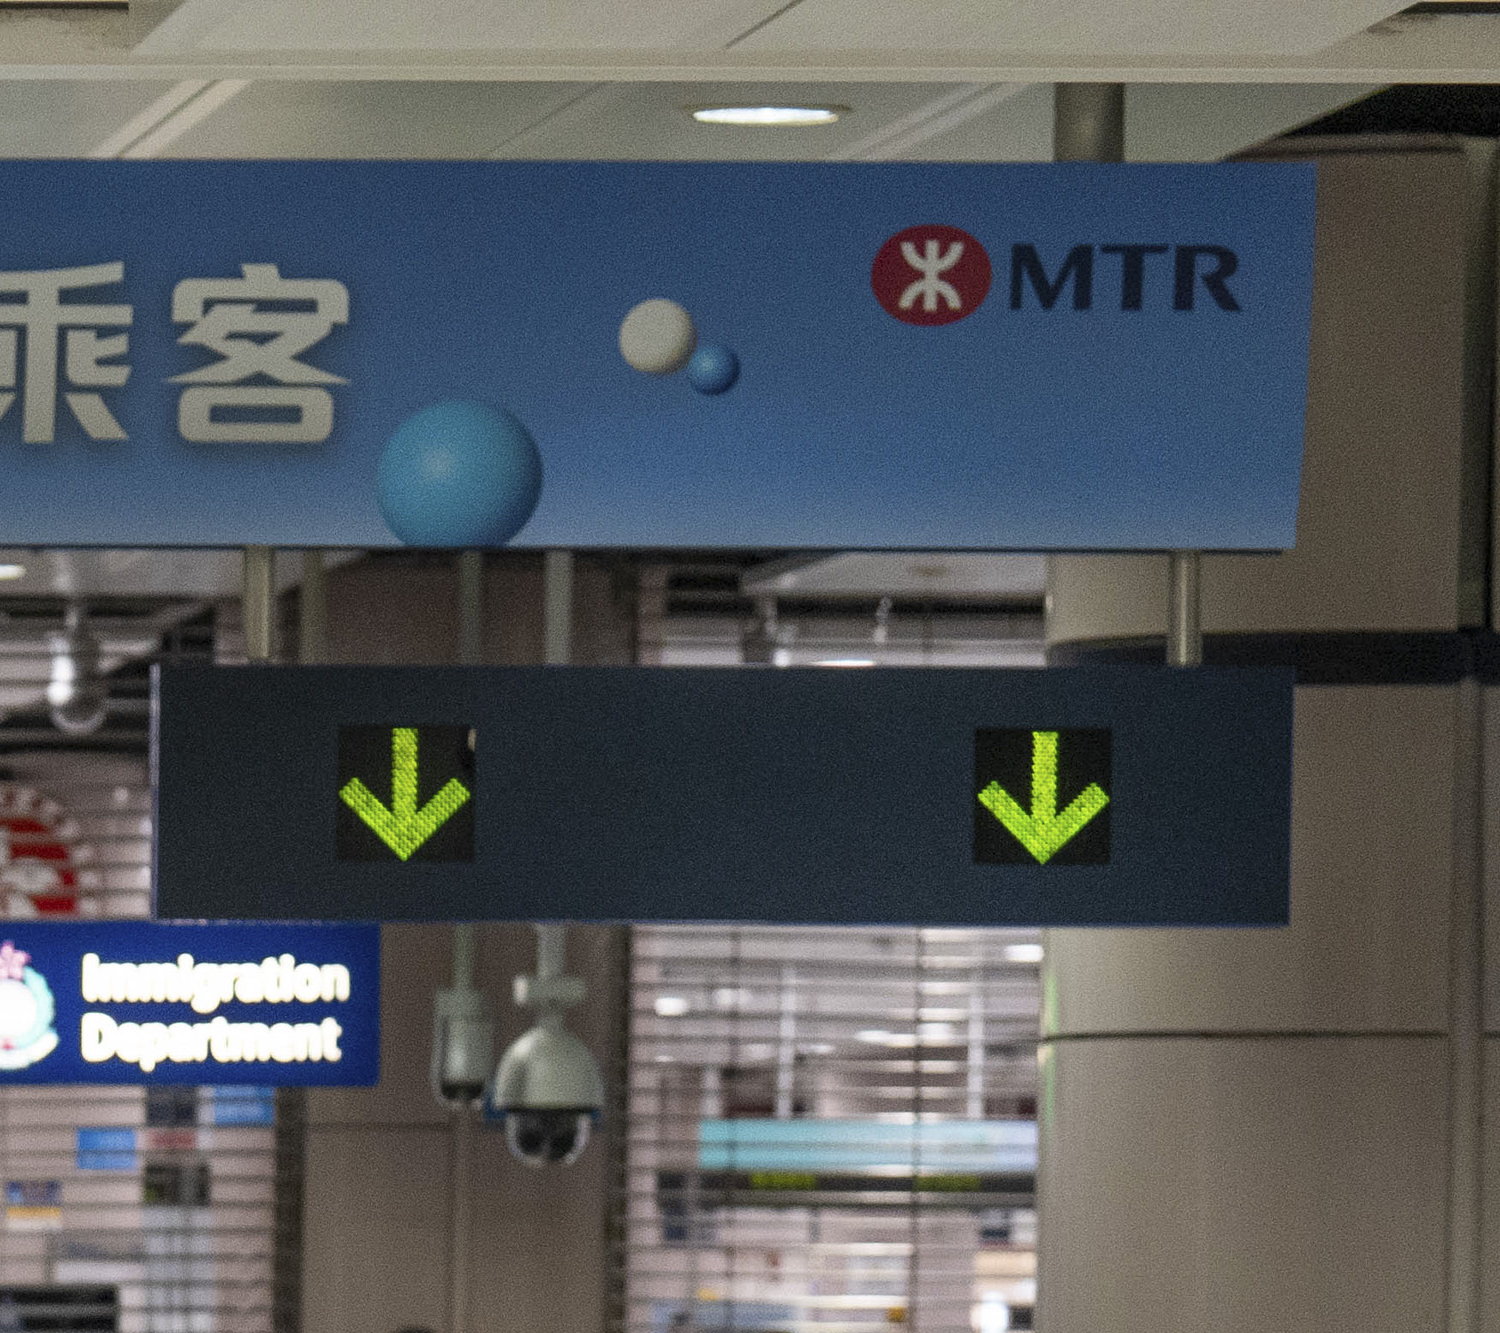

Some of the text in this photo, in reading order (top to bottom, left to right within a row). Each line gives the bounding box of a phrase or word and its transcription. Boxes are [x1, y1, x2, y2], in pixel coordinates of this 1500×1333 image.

[1008, 242, 1242, 313] MTR
[80, 953, 351, 1014] Immigration
[80, 1011, 343, 1073] Department
